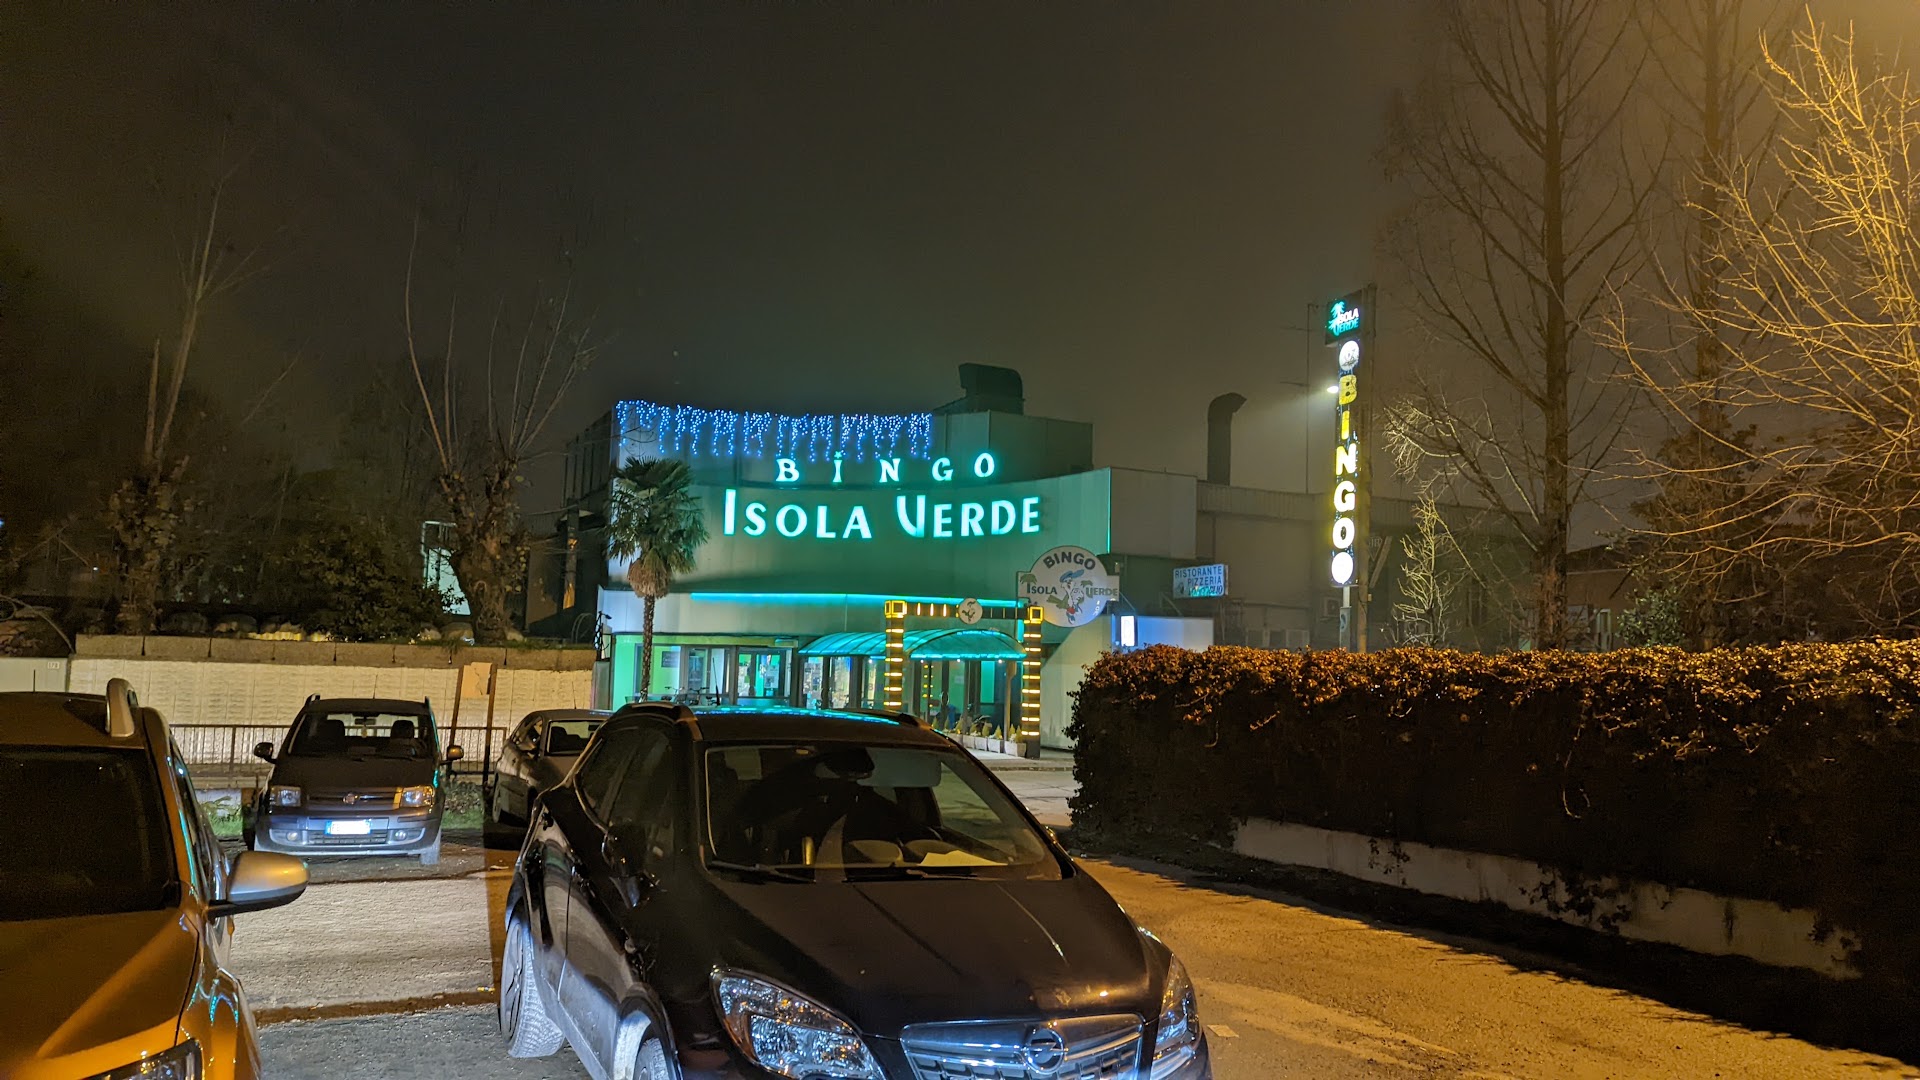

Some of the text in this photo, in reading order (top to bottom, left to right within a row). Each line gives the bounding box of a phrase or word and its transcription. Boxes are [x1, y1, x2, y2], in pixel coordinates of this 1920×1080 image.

[775, 452, 995, 483] BINGO
[1332, 374, 1358, 549] BINGO
[723, 489, 1040, 539] ISOLA VERDE
[1043, 551, 1096, 570] BINGO
[1174, 565, 1222, 578] RISTORANTE
[1026, 582, 1119, 598] ISOLA VERDE
[1187, 576, 1222, 587] PIZZERIA
